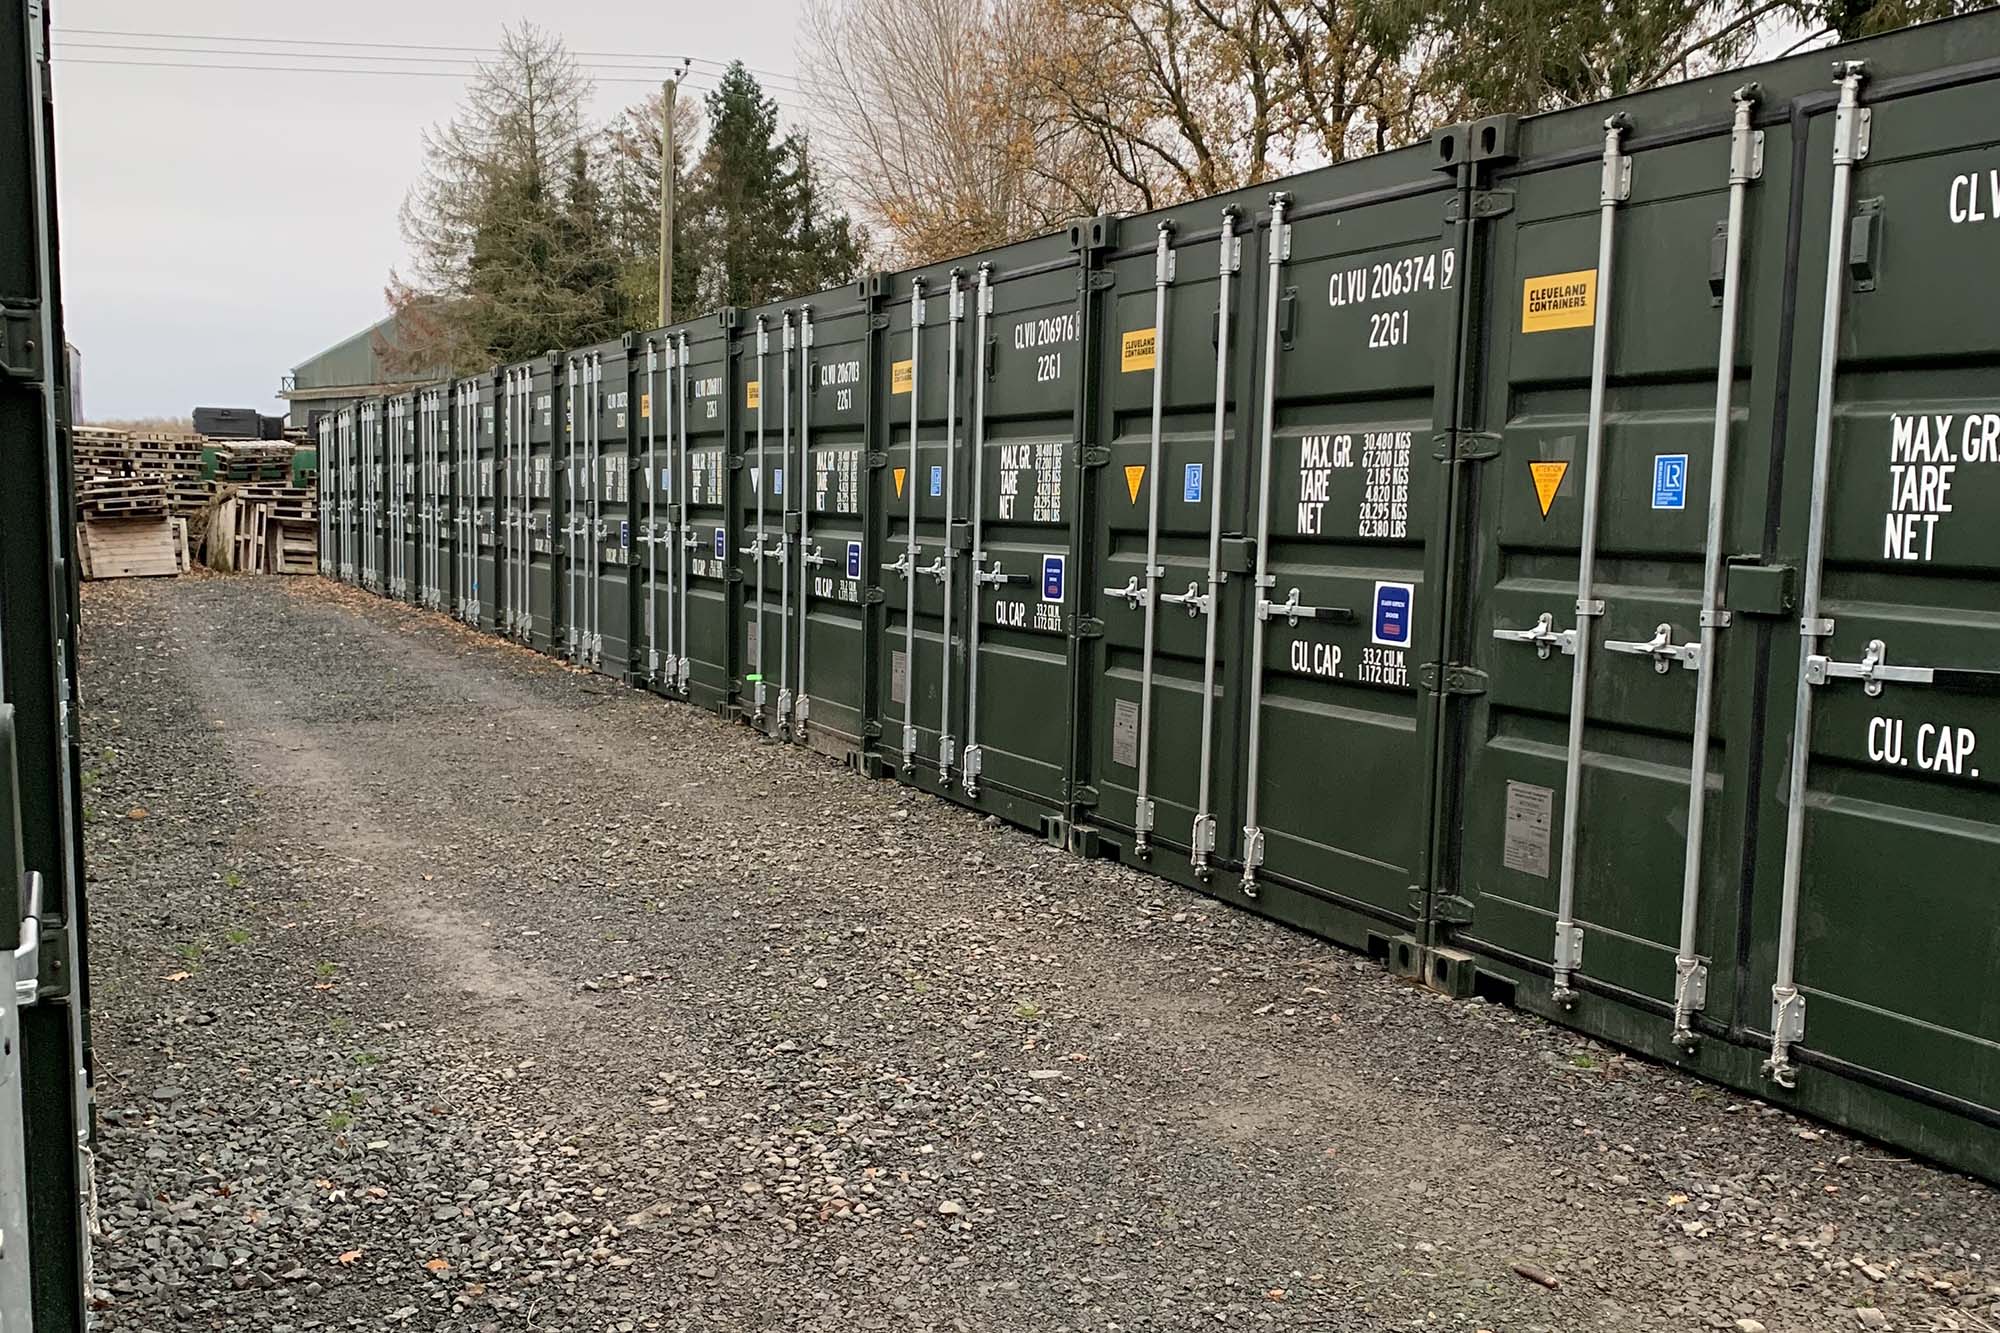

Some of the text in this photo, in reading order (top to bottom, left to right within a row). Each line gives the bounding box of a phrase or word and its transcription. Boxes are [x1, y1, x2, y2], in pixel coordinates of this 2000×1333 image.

[1329, 268, 1367, 306] CLVU
[1371, 254, 1435, 299] 206374
[1530, 283, 1586, 301] CLEVELAND
[1015, 321, 1035, 349] CLVU
[1038, 315, 1073, 345] 206976
[1369, 310, 1408, 348] 22G1
[1038, 352, 1060, 382] 22G1
[1301, 431, 1411, 468] MAX. GR. 30.480 KGS
[1891, 415, 1958, 463] MAX.
[1001, 445, 1018, 470] MAX.
[1362, 450, 1409, 468] 67.200 LBS
[1001, 470, 1018, 495] TARE
[1300, 467, 1409, 501] TARE 2.185 KGS
[1666, 464, 1680, 487] LR
[1890, 465, 1955, 512] TARE
[1000, 495, 1015, 519] NET
[1365, 485, 1408, 503] 4.820 LBS
[1298, 502, 1408, 534] NET 28.295 KGS
[1359, 520, 1406, 538] 62.380 LBS
[1884, 513, 1939, 560] NET
[1009, 601, 1027, 628] CAP.
[1291, 640, 1311, 673] CU.
[1314, 643, 1344, 678] CAP.
[1362, 648, 1381, 665] 33.2
[1358, 664, 1382, 683] 1.172
[1868, 716, 1979, 777] CU. CAP.
